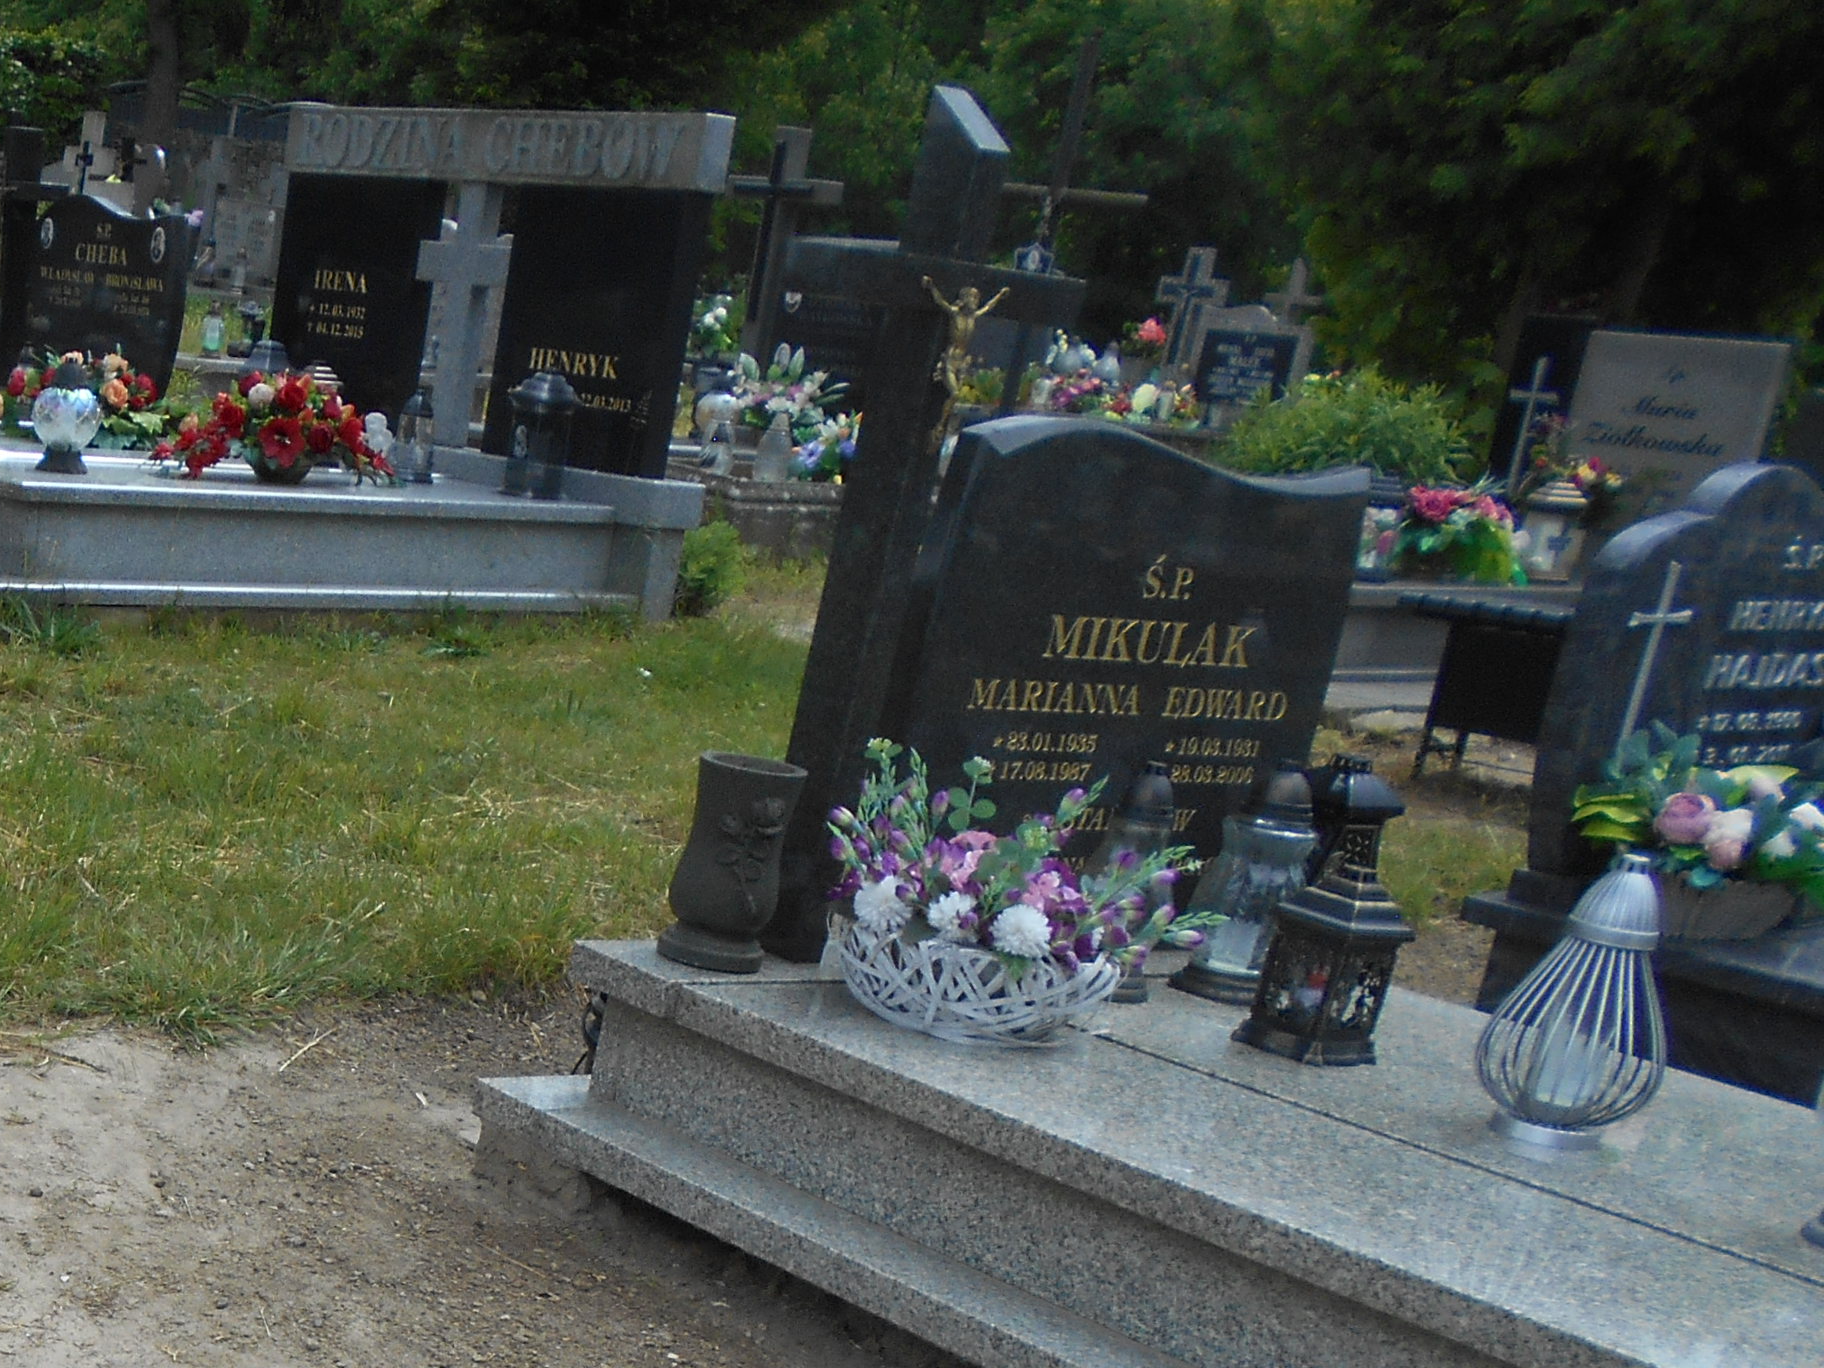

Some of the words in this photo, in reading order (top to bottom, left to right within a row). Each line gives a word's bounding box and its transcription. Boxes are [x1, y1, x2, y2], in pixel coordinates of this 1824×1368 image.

[296, 112, 464, 170] RODZINA
[75, 242, 128, 267] CHEBA
[314, 269, 368, 294] IRENA
[528, 347, 620, 380] HENRYK
[1142, 553, 1196, 601] Ś.P.
[1041, 613, 1258, 668] MIKULAK
[967, 678, 1142, 716] MARIANNA
[1161, 686, 1289, 722] EDWARD
